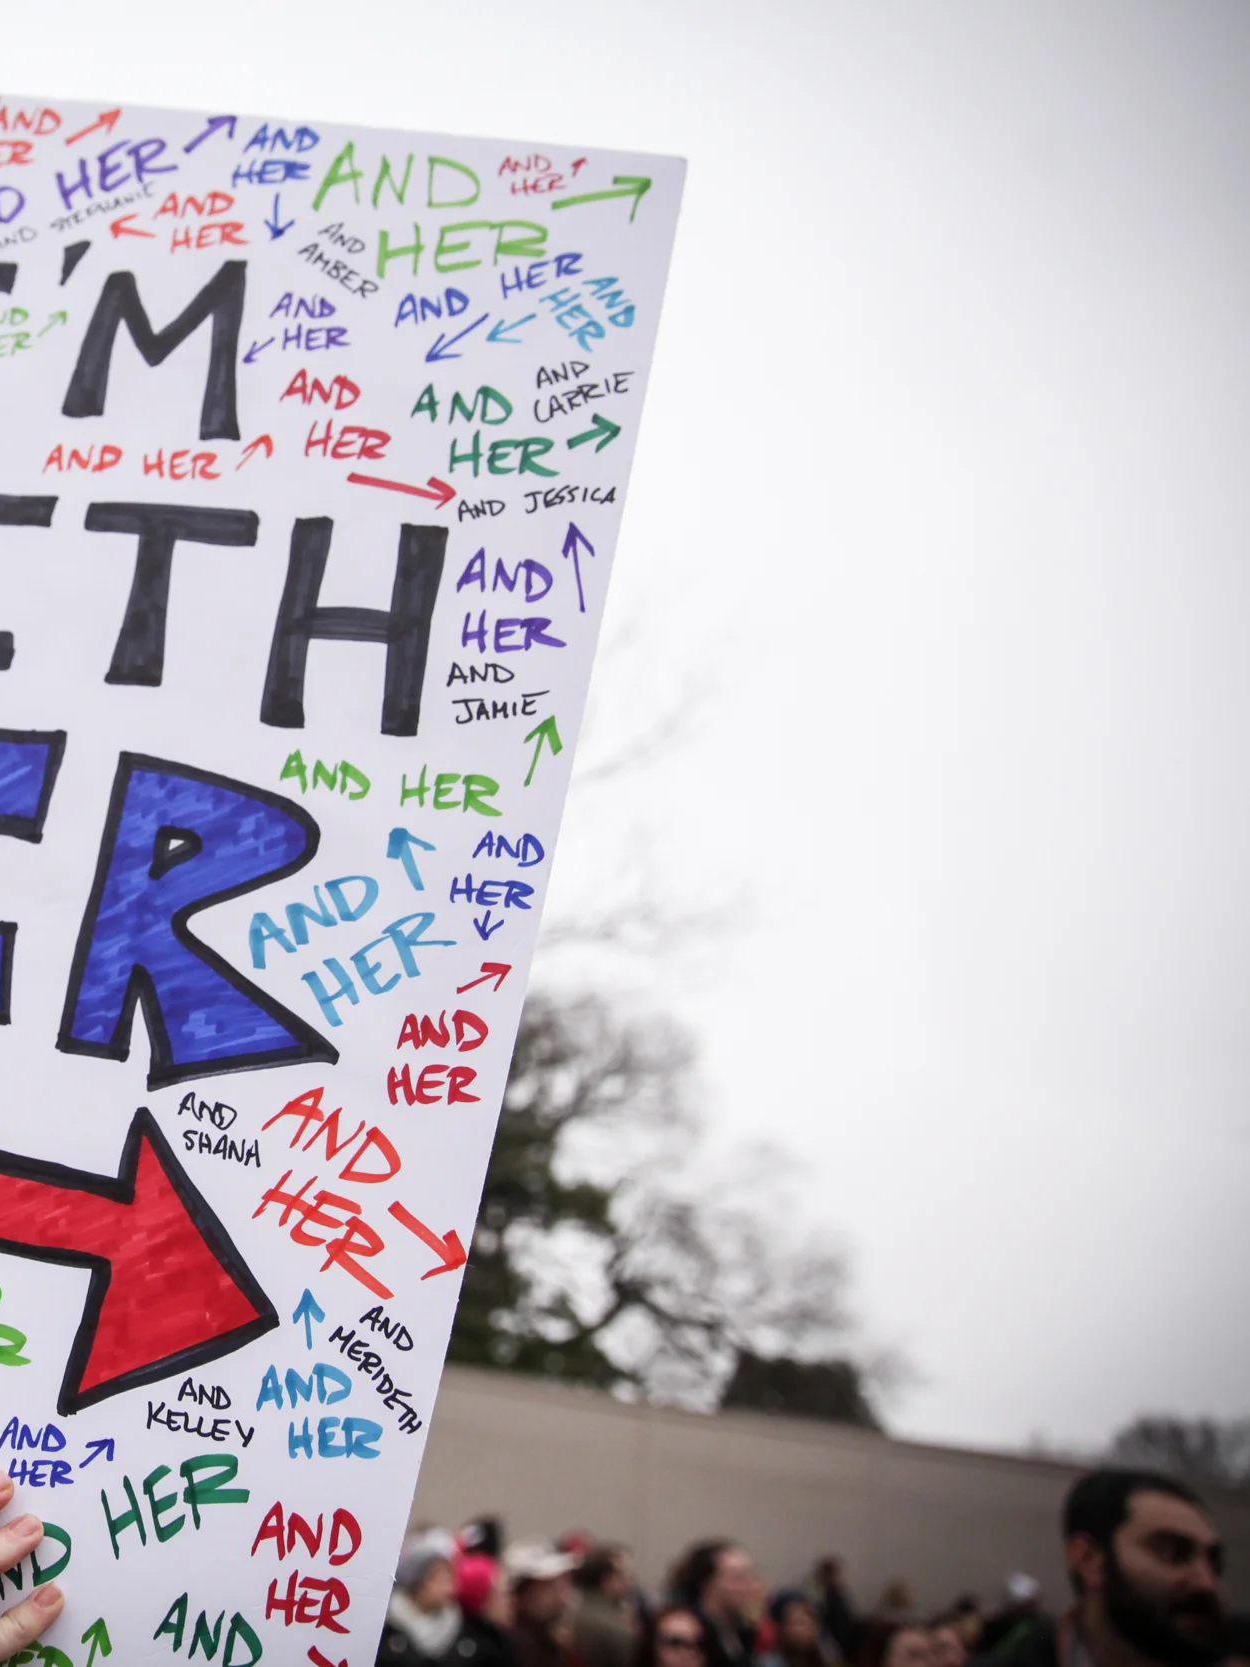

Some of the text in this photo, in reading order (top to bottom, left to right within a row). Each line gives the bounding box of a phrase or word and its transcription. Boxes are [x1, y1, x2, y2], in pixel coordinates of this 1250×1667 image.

[243, 123, 320, 153] AND
[55, 137, 179, 212] HER
[231, 159, 311, 188] HER
[311, 140, 481, 212] AND
[498, 157, 551, 176] AND
[510, 173, 567, 196] HER
[153, 190, 235, 220] AND
[170, 221, 250, 254] HER
[318, 222, 366, 254] AND
[376, 219, 549, 279] HER
[298, 243, 379, 299] AMBER
[394, 252, 583, 328] AND HER
[269, 292, 336, 319] AND
[539, 287, 606, 353] HER
[582, 276, 636, 328] AND
[282, 323, 350, 352] HER
[279, 368, 361, 411] AND
[534, 366, 634, 423] CARRIE
[536, 361, 590, 389] AND
[410, 383, 513, 425] AND
[304, 418, 392, 460] HER
[449, 429, 560, 478] HER
[43, 444, 221, 481] AND HER
[458, 485, 616, 522] AND JESSICA
[456, 547, 553, 603] AND
[461, 609, 567, 654] HER
[446, 662, 515, 687] AND
[452, 690, 550, 724] JAMIE
[280, 750, 502, 817] AND HER
[472, 830, 545, 867] AND
[450, 873, 535, 910] HER
[249, 876, 378, 969] AND
[301, 912, 457, 1027] HER
[397, 1009, 489, 1052] AND
[387, 1063, 481, 1106] HER
[178, 1092, 237, 1131] AND
[183, 1130, 261, 1168] SHANA
[261, 1086, 401, 1184] AND
[252, 1169, 394, 1300] HER
[359, 1306, 414, 1351] AND
[178, 1377, 231, 1410] AND
[256, 1363, 352, 1412] AND
[328, 1326, 422, 1434] MERIDETH
[147, 1401, 254, 1448] KELLEY
[288, 1416, 383, 1459] HER
[8, 1458, 74, 1488] HER
[101, 1454, 250, 1560] HER
[251, 1501, 362, 1566] AND
[265, 1569, 351, 1634] HER
[153, 1592, 263, 1667] AND
